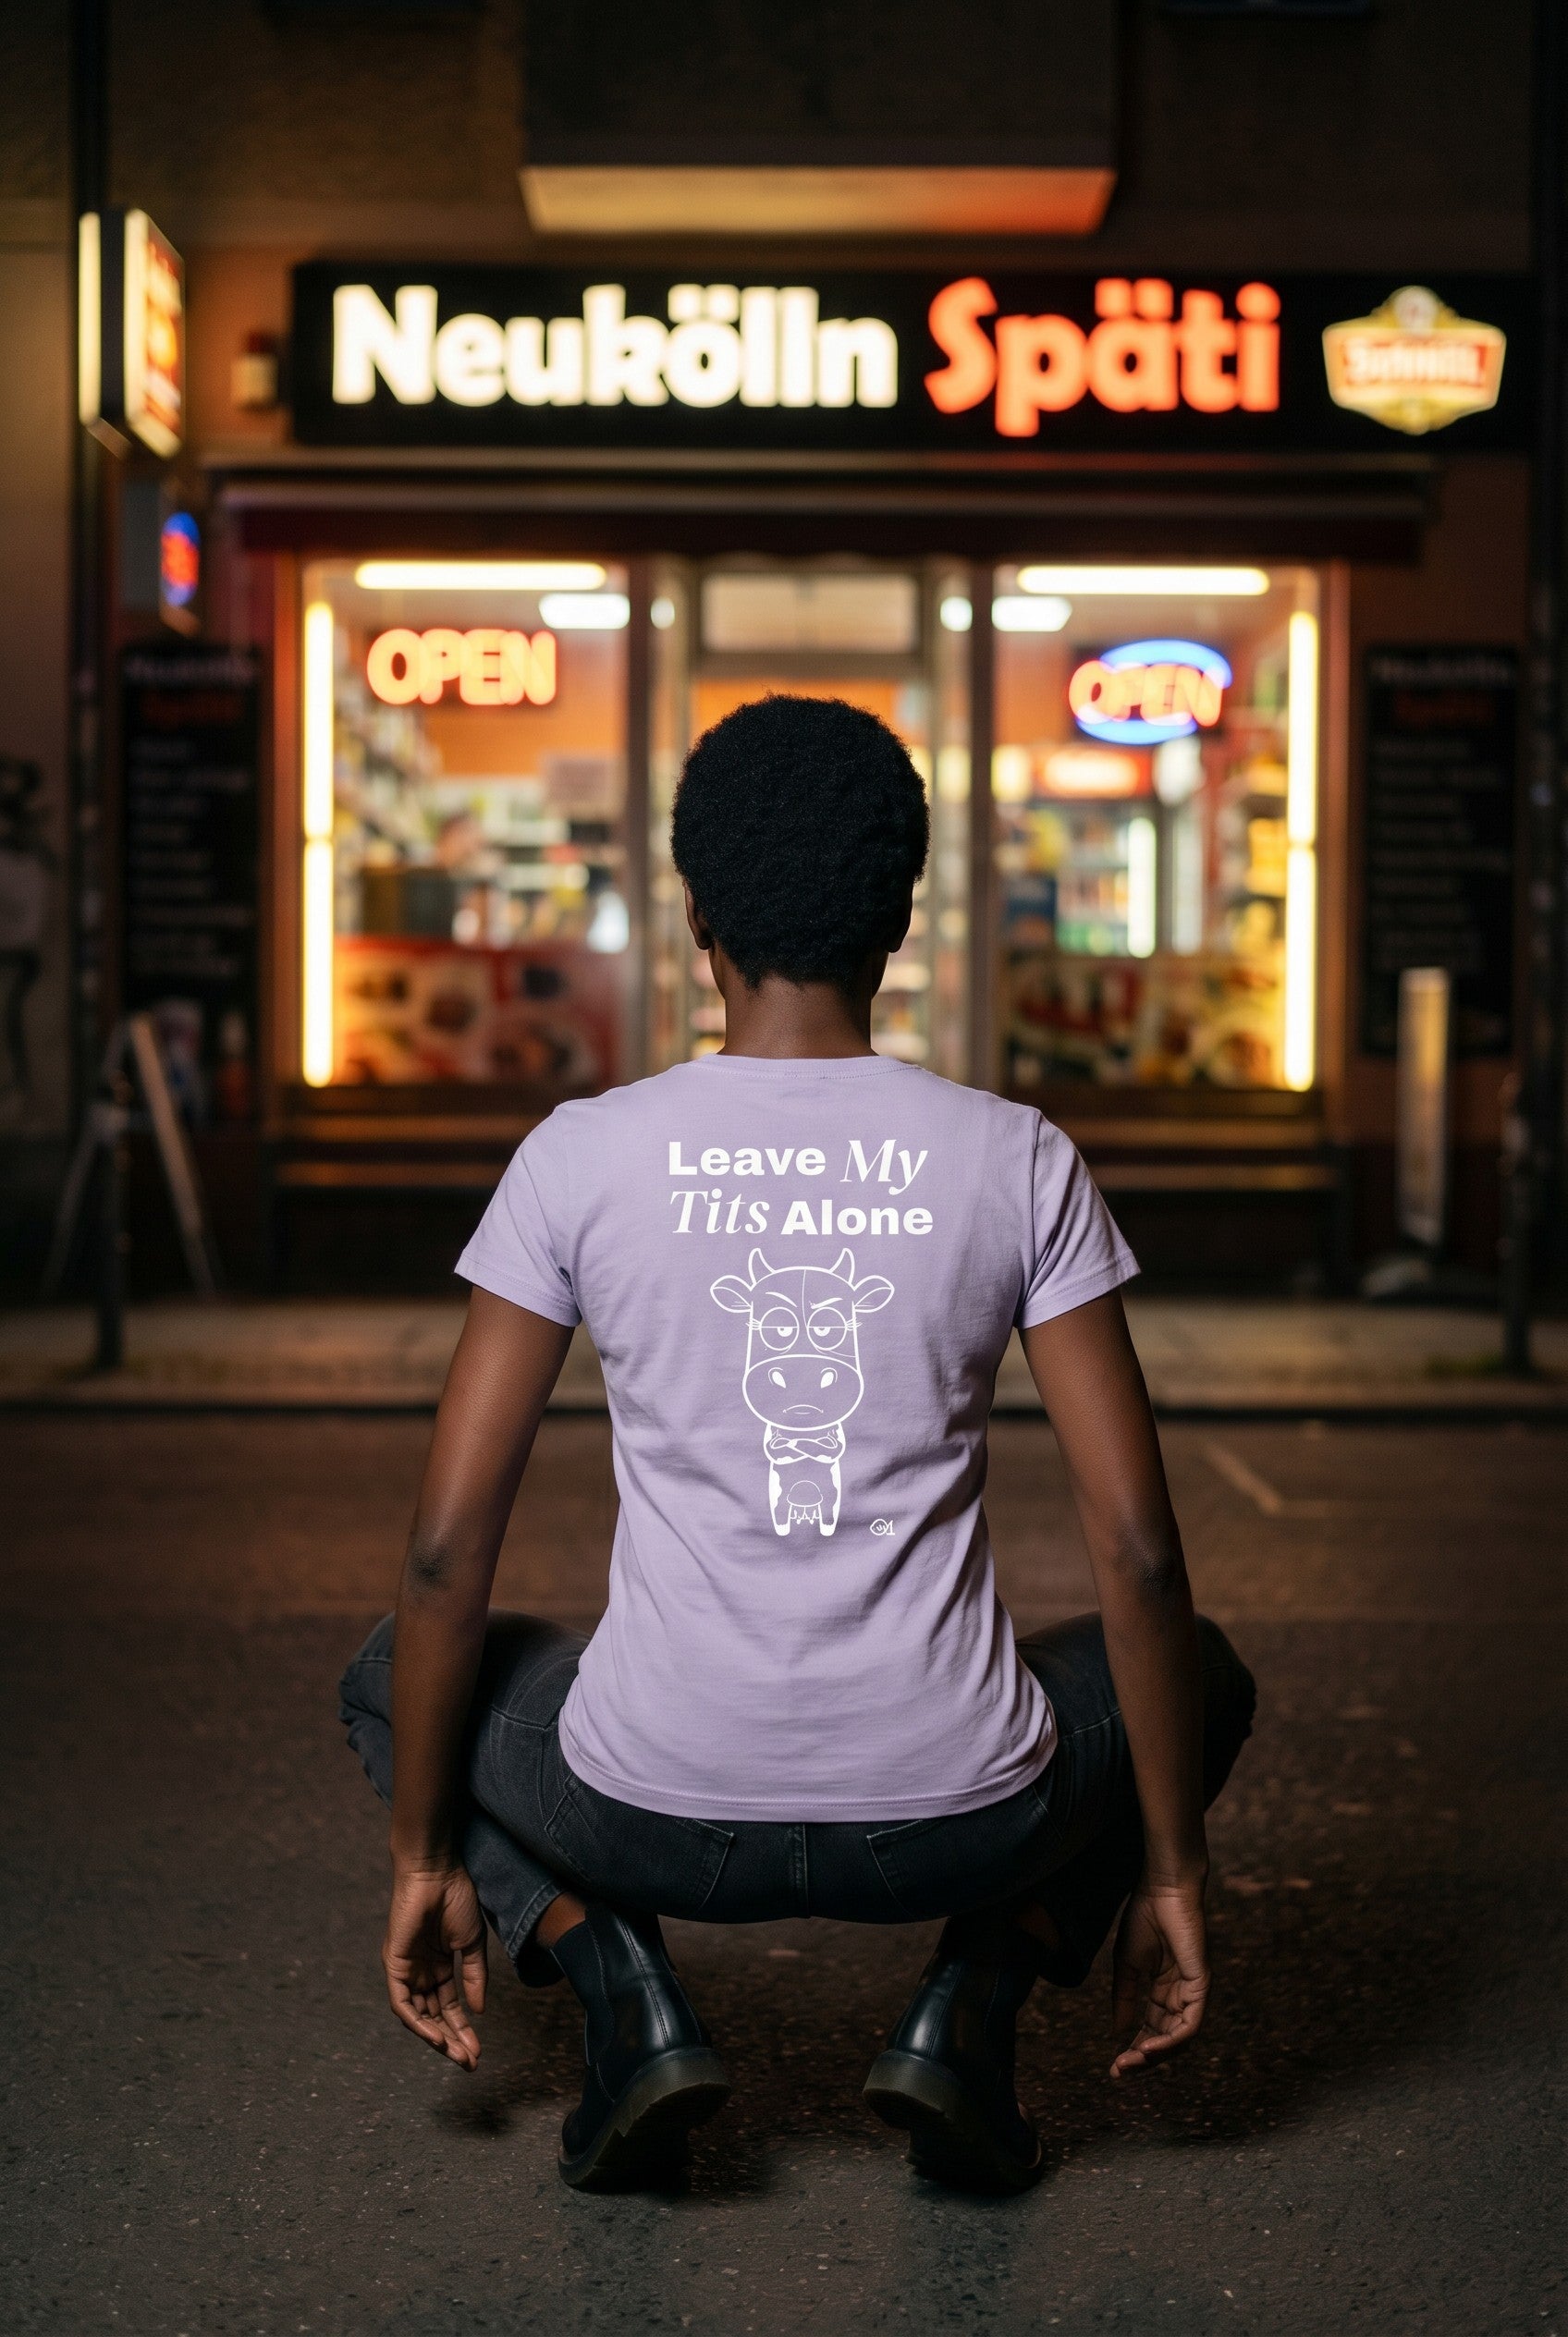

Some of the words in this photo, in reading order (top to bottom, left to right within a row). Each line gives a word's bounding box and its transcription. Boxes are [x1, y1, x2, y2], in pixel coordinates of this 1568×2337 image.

[332, 283, 899, 409] Neukölln
[925, 276, 1281, 437] Späti
[366, 628, 557, 706] OPEN
[1069, 660, 1224, 727] OPEN
[668, 1141, 827, 1176] Leave
[840, 1139, 929, 1195] My
[670, 1188, 770, 1235] Tits
[780, 1199, 934, 1236] Alone
